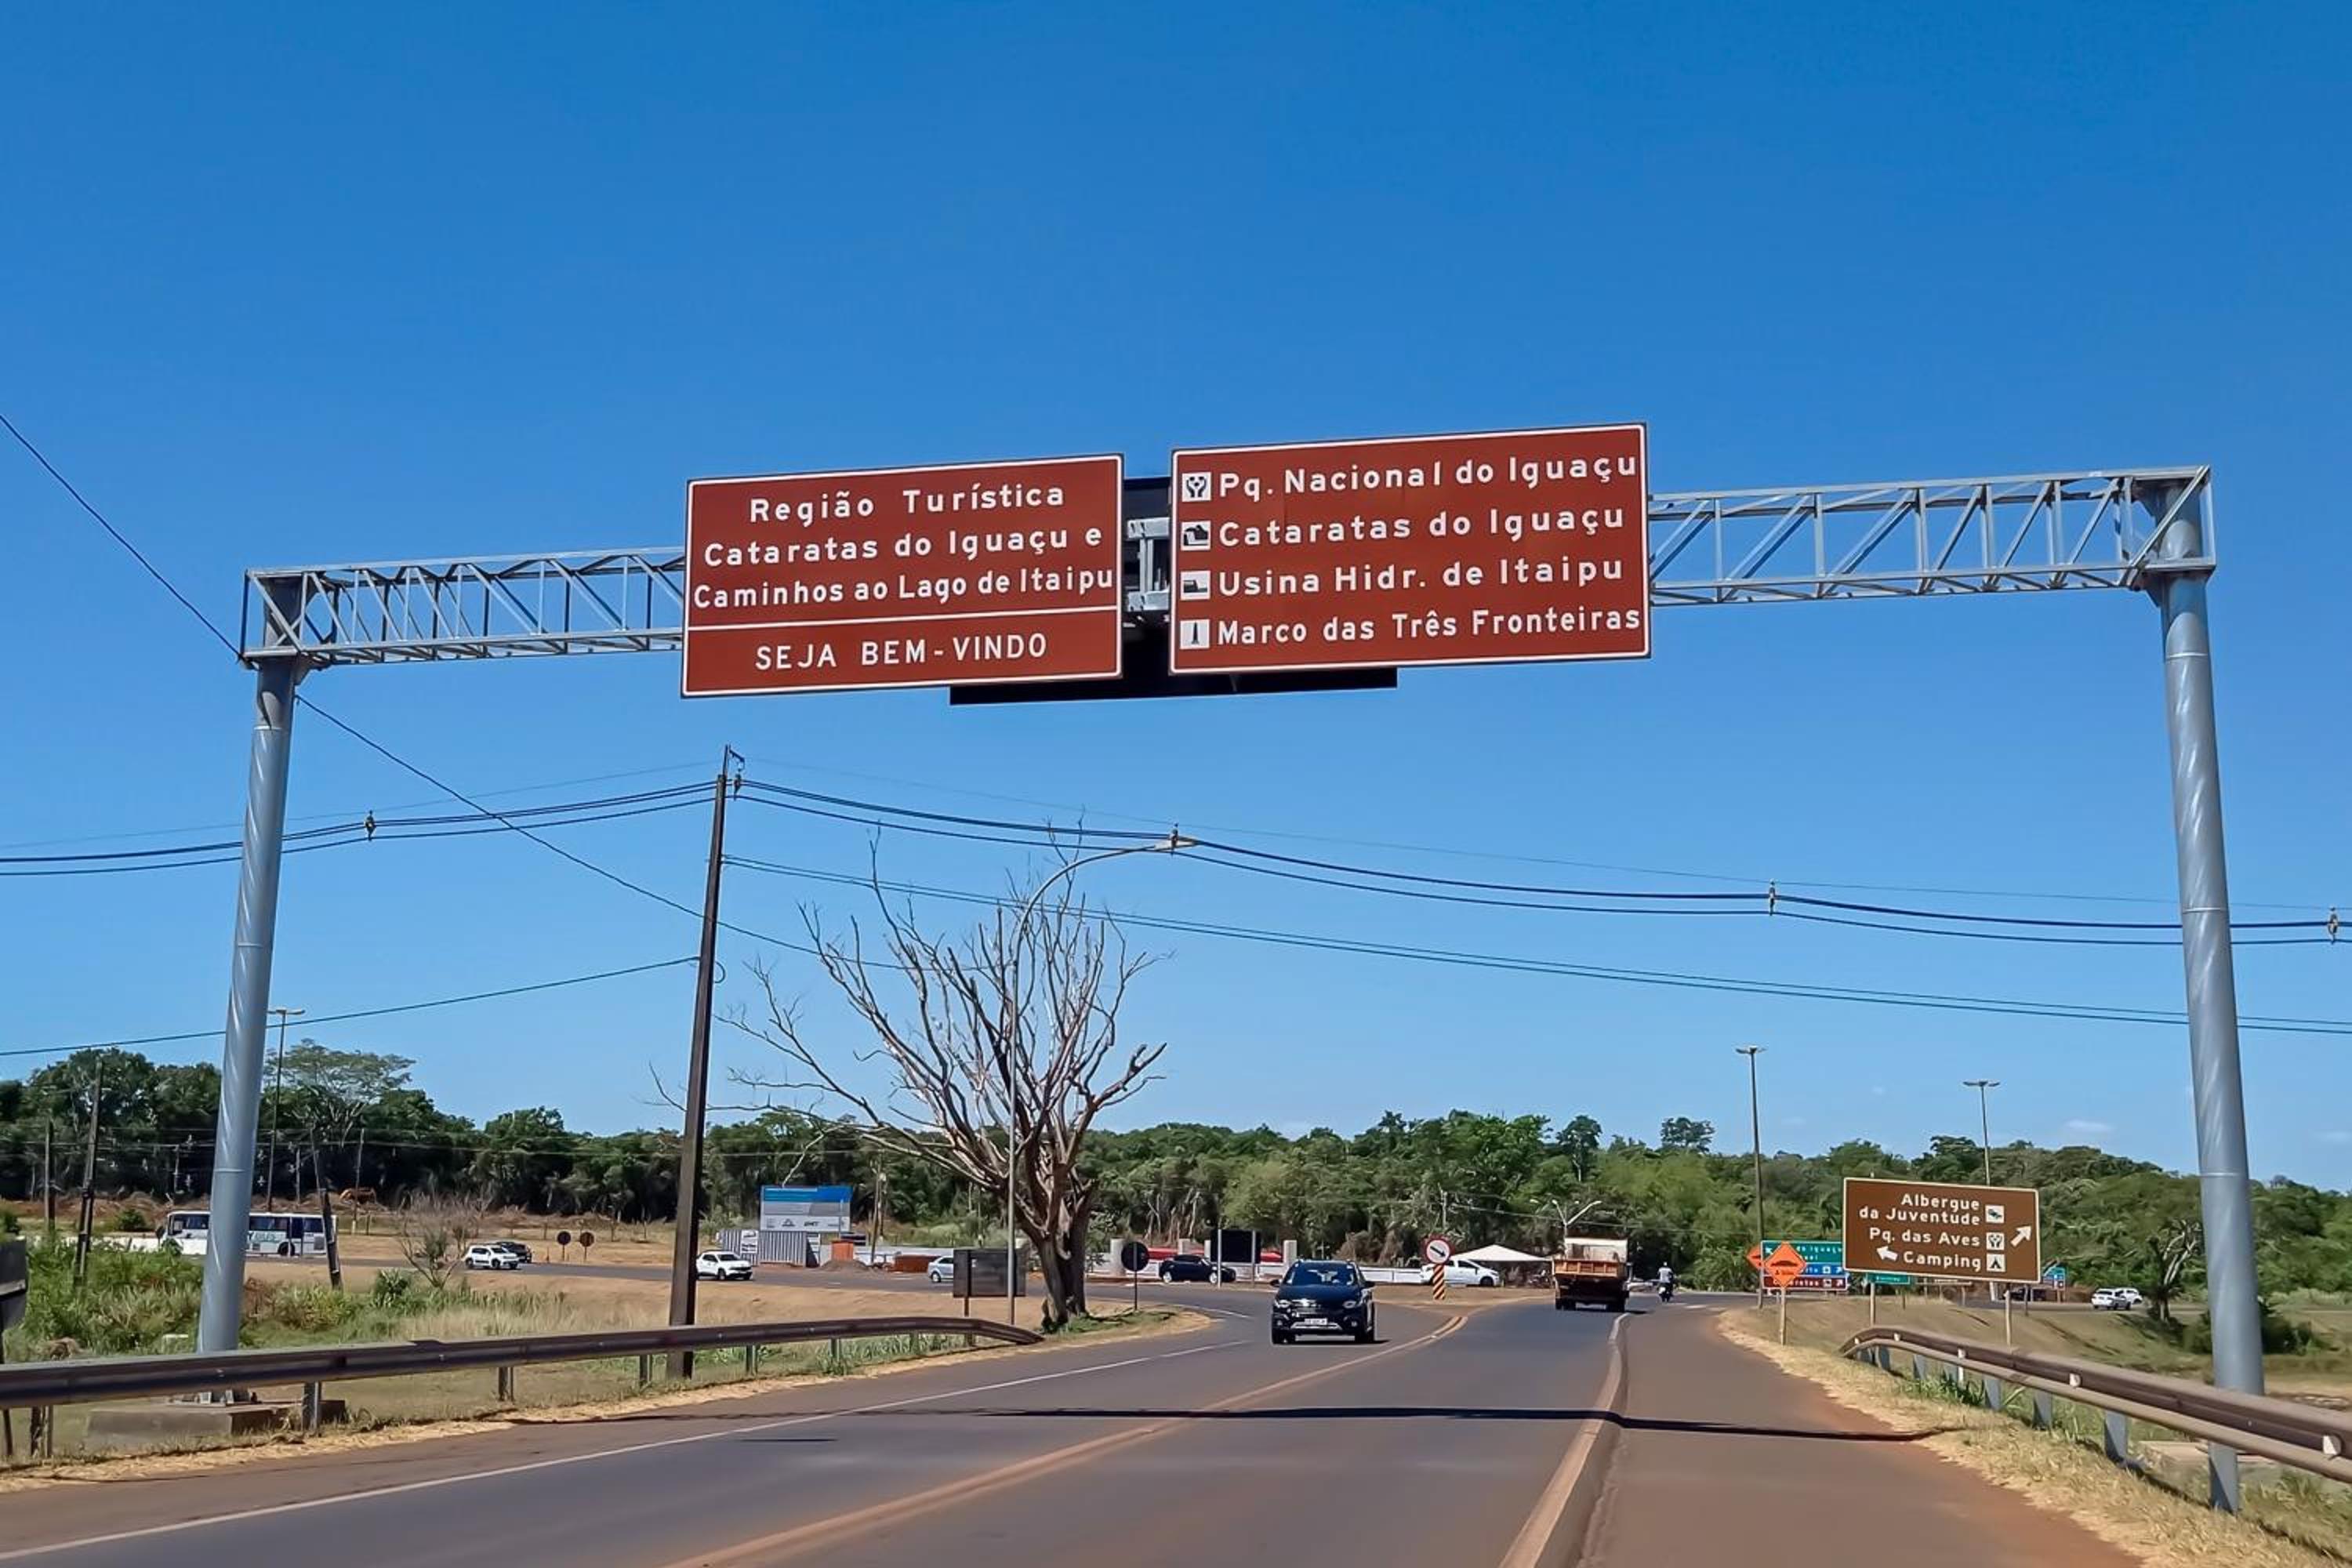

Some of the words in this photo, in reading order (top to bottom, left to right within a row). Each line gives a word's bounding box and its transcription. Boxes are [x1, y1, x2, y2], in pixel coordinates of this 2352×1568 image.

[1220, 473, 1273, 503] Pq.
[1285, 461, 1440, 493] Nacional
[1456, 459, 1494, 484] do
[1509, 456, 1635, 489] Iguaçu
[750, 491, 874, 528] Região
[902, 482, 1063, 514] Turística
[1219, 515, 1410, 546] Cataratas
[1429, 511, 1471, 536] do
[1490, 509, 1623, 542] Iguaçu
[704, 536, 877, 568] Cataratas
[895, 532, 931, 557] do
[949, 529, 1067, 561] Iguaçu
[1085, 528, 1102, 546] e
[694, 580, 844, 608] Caminhos
[854, 581, 888, 601] ao
[899, 574, 967, 604] Lago
[978, 570, 1010, 595] de
[1020, 566, 1112, 595] Itaipu
[1219, 569, 1319, 597] Usina
[1335, 562, 1426, 592] Hidr.
[1443, 561, 1483, 586] de
[1501, 556, 1621, 587] Itaipu
[1218, 621, 1307, 646] Marco
[1323, 615, 1374, 641] das
[1392, 610, 1457, 638] Três
[1472, 605, 1640, 635] Fronteiras
[755, 643, 837, 671] SEJA
[1858, 1206, 1879, 1220] da
[1886, 1207, 1980, 1225] Juventude
[1900, 1193, 1980, 1213] Albergue
[1869, 1227, 1896, 1243] Pq.
[1901, 1229, 1932, 1243] das
[1938, 1232, 1980, 1247] Aves
[1903, 1250, 1981, 1272] Camping
